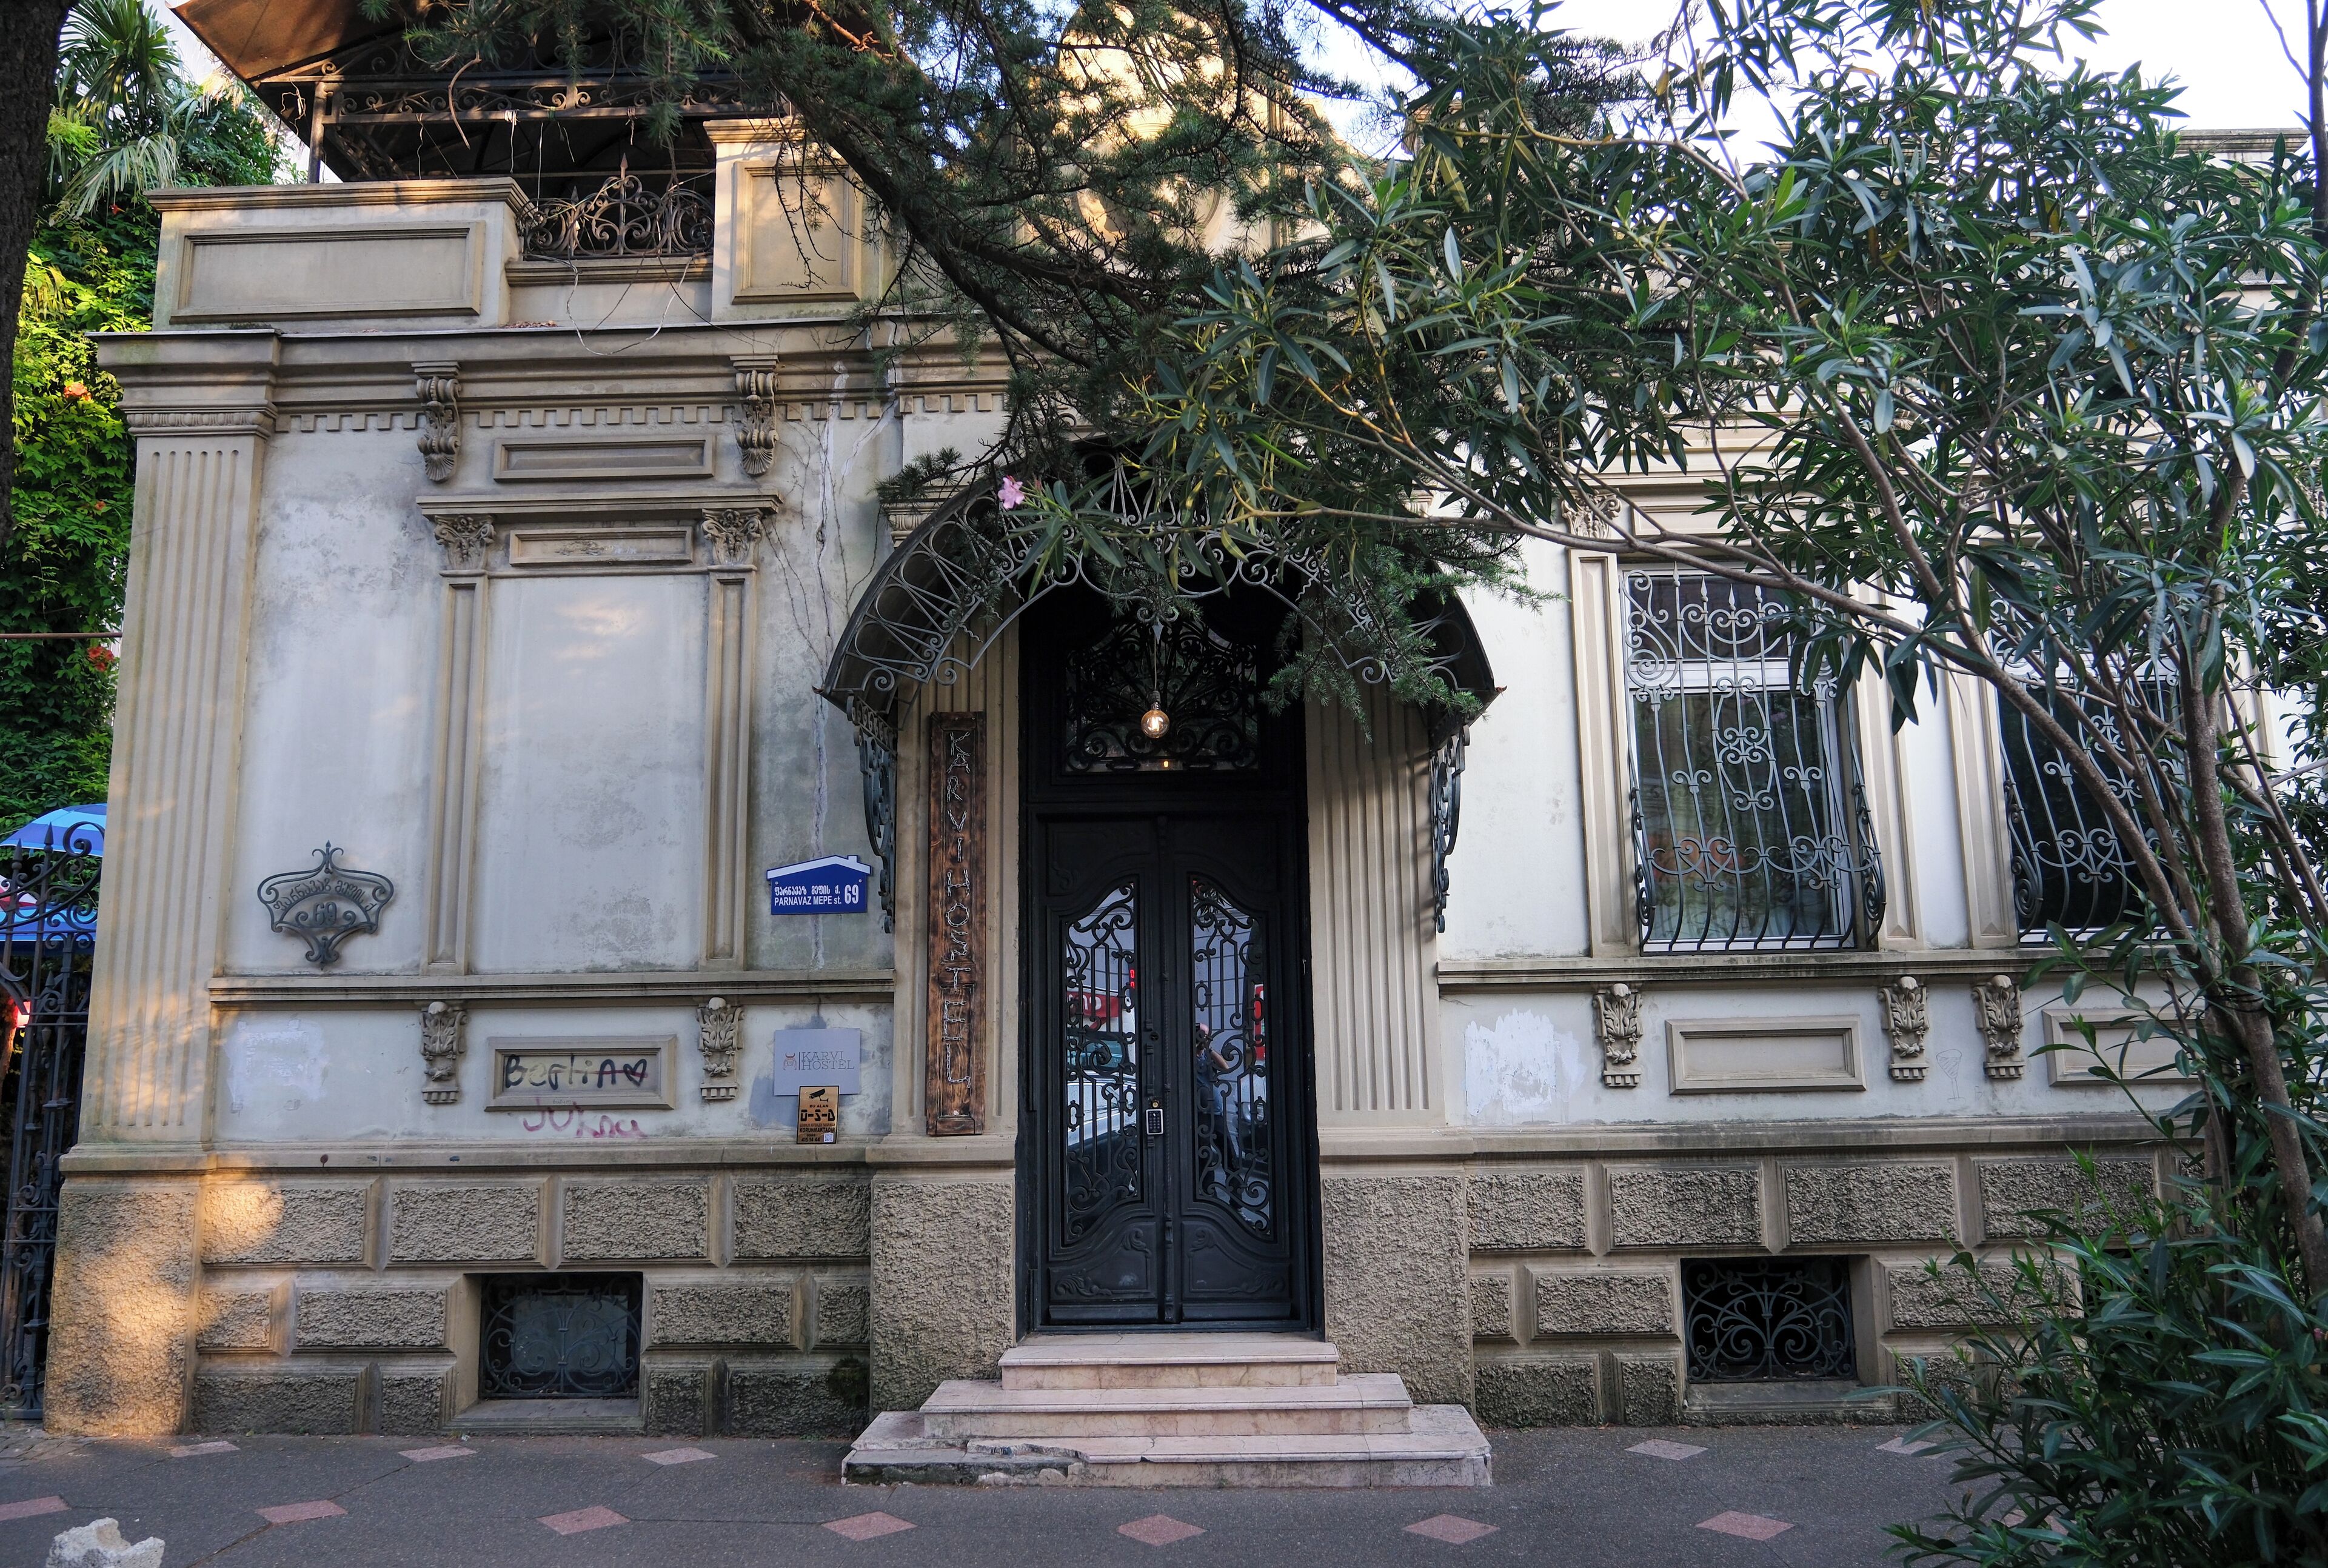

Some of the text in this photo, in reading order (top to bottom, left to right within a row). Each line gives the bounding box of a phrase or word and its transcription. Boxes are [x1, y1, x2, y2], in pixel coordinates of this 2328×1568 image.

[774, 886, 807, 896] ფარნავაზ
[811, 885, 830, 895] მეფის
[844, 884, 859, 904] 69
[774, 895, 842, 906] PARNAVAZ MEPE st.
[313, 901, 338, 926] 69
[942, 732, 971, 1088] KARVI HOSTEL
[801, 1051, 844, 1061] KARVI
[801, 1060, 855, 1070] HOSTEL
